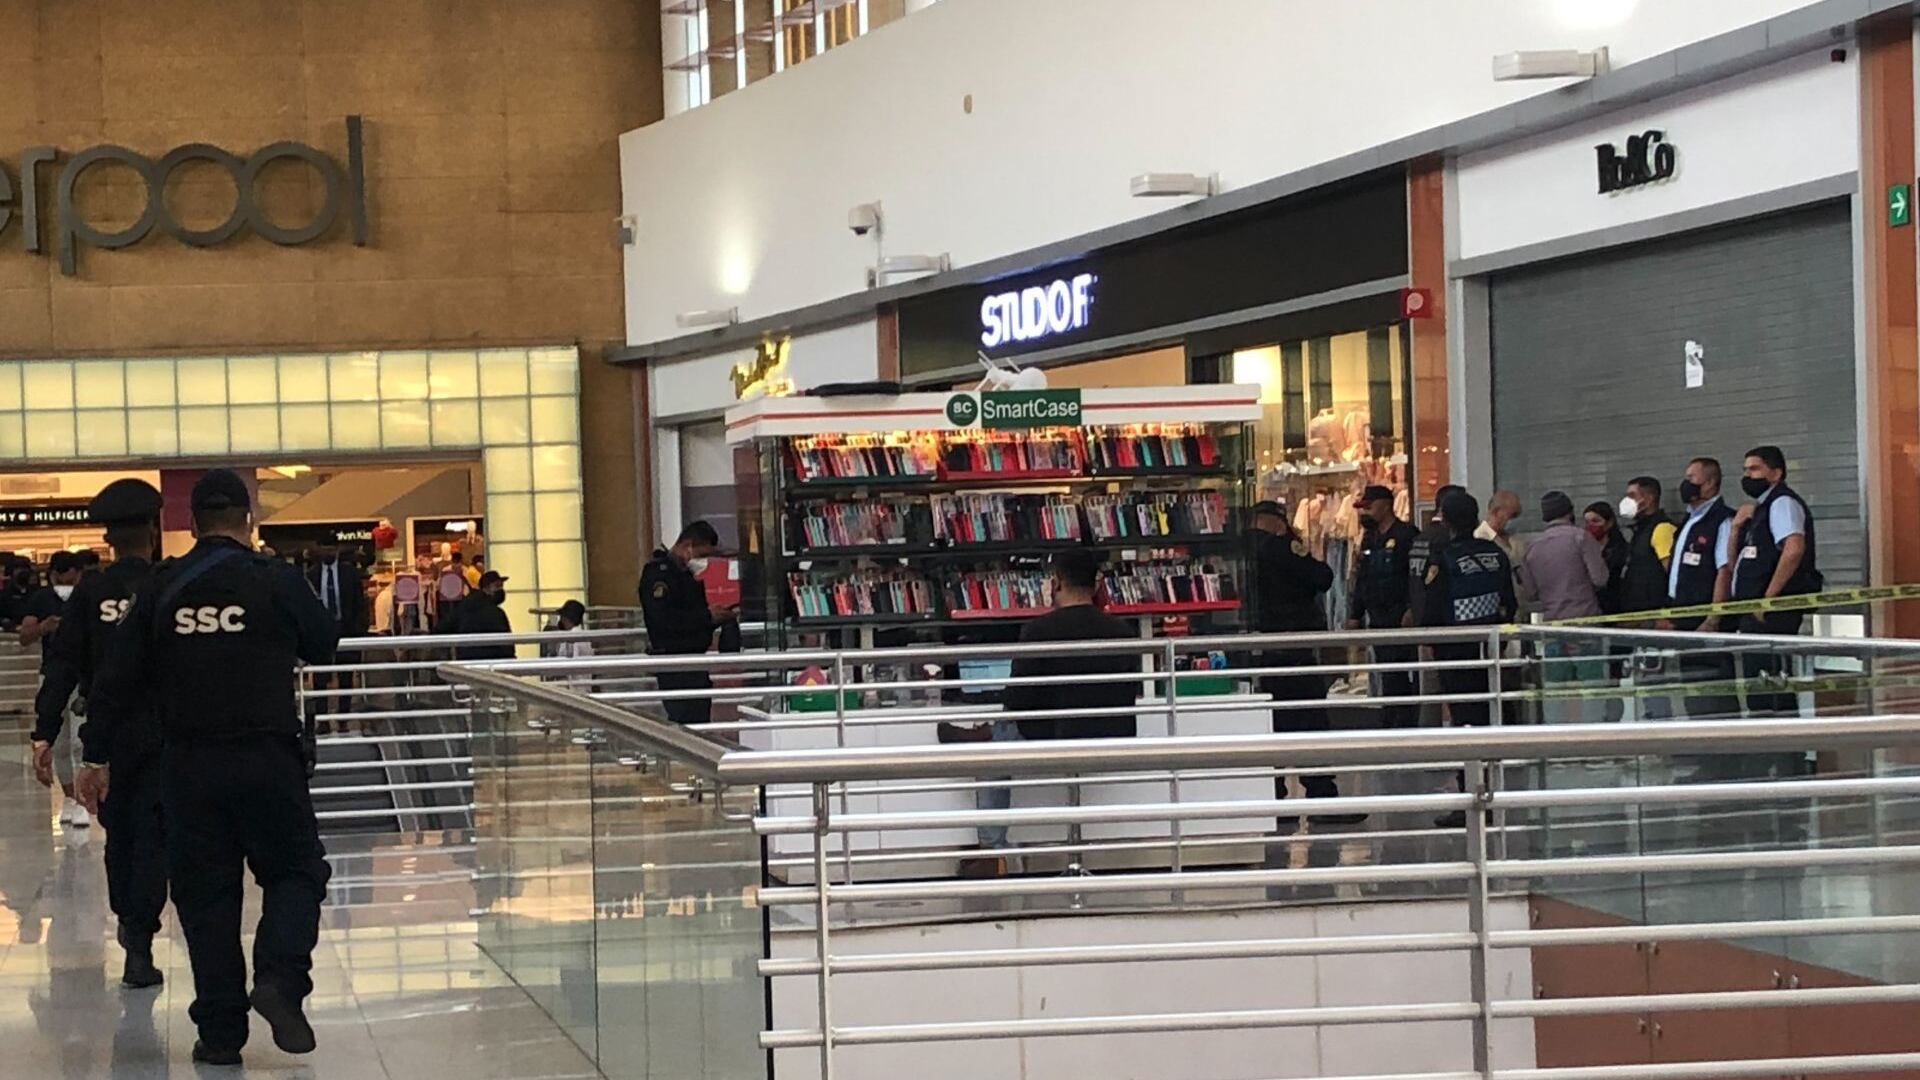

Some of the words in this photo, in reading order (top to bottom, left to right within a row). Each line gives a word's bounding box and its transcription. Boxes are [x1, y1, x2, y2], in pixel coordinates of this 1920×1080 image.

[953, 402, 972, 413] SC
[983, 398, 1079, 419] SmartCase
[175, 605, 246, 635] SSC
